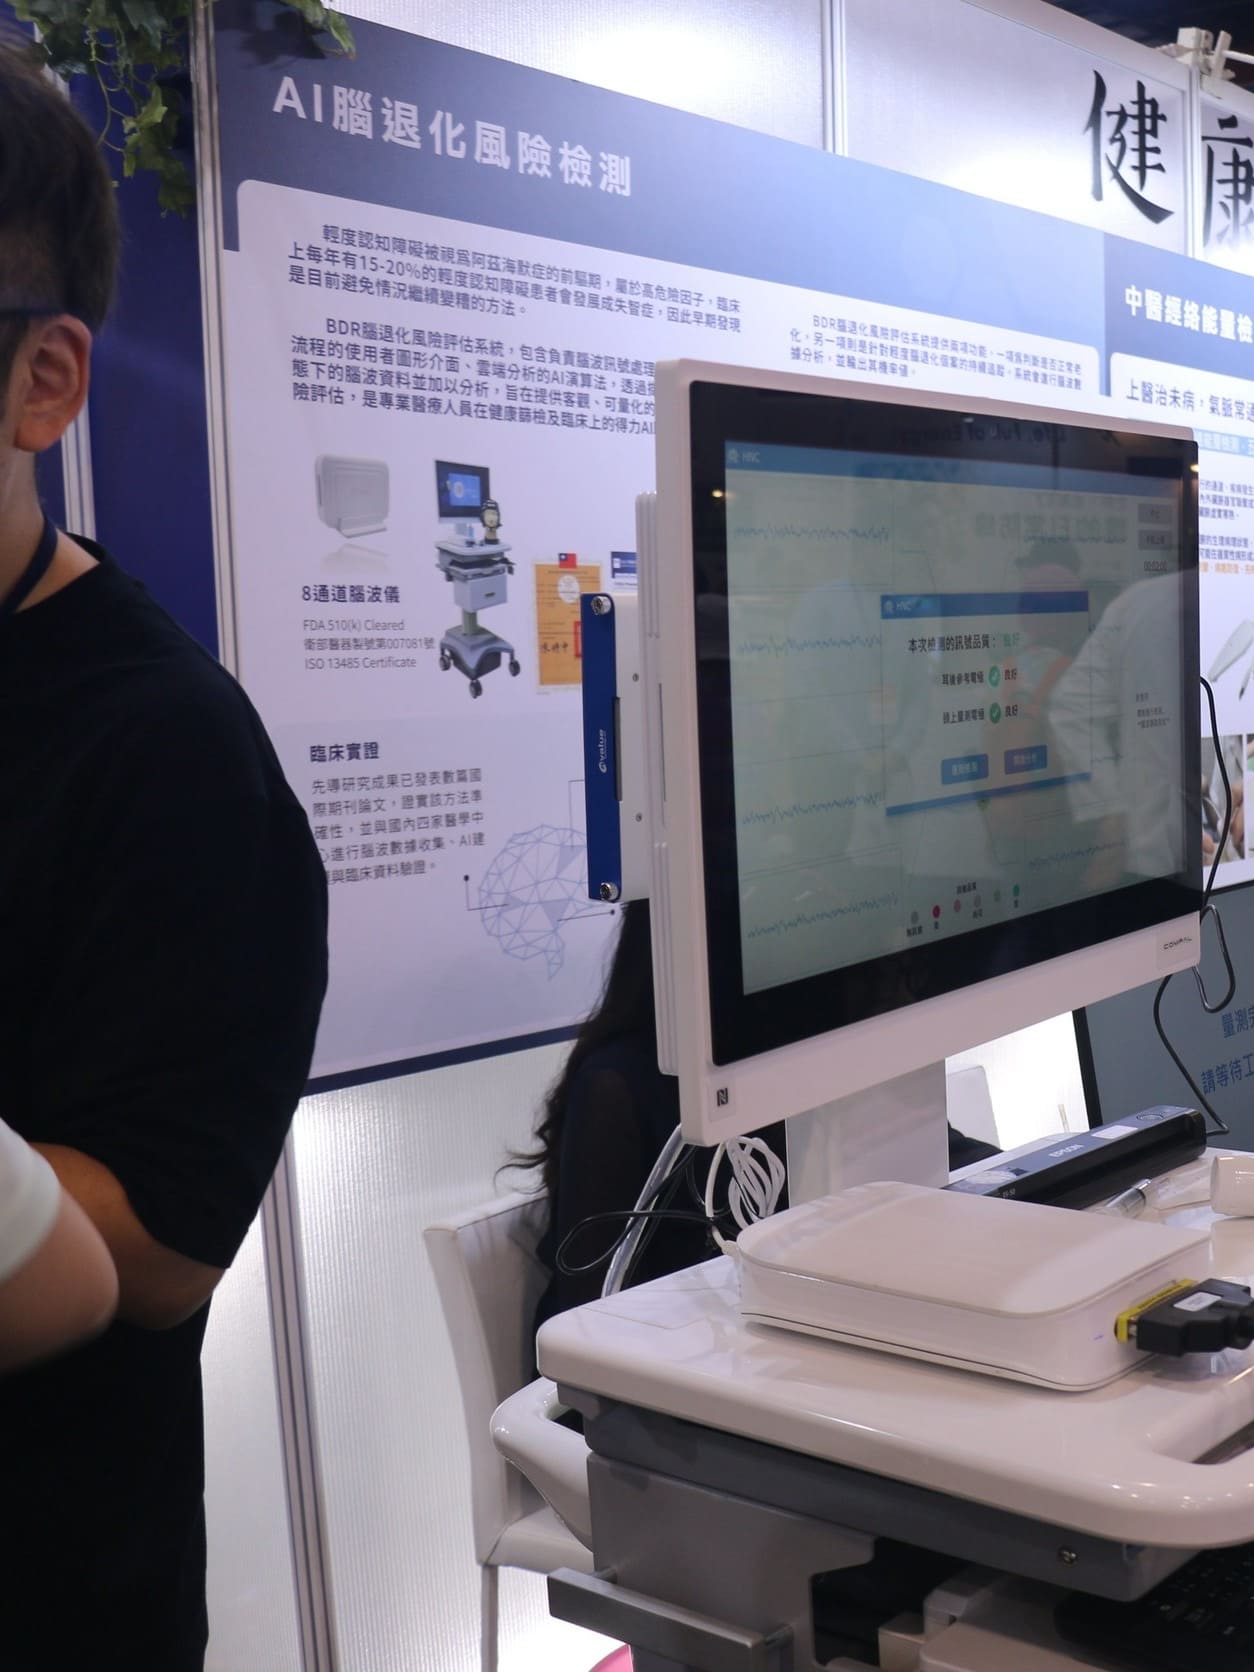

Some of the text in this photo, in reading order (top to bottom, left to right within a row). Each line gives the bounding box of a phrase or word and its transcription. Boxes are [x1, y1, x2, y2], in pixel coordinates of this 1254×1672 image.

[273, 76, 632, 196] AI腦退化風險檢測
[301, 584, 400, 603] 8通道腦波儀
[303, 619, 405, 633] FDA 510(k) Cleared
[305, 656, 417, 670] ISO 13485 Certificate
[309, 741, 379, 763] 臨床實證
[1049, 1143, 1084, 1159] EPSON
